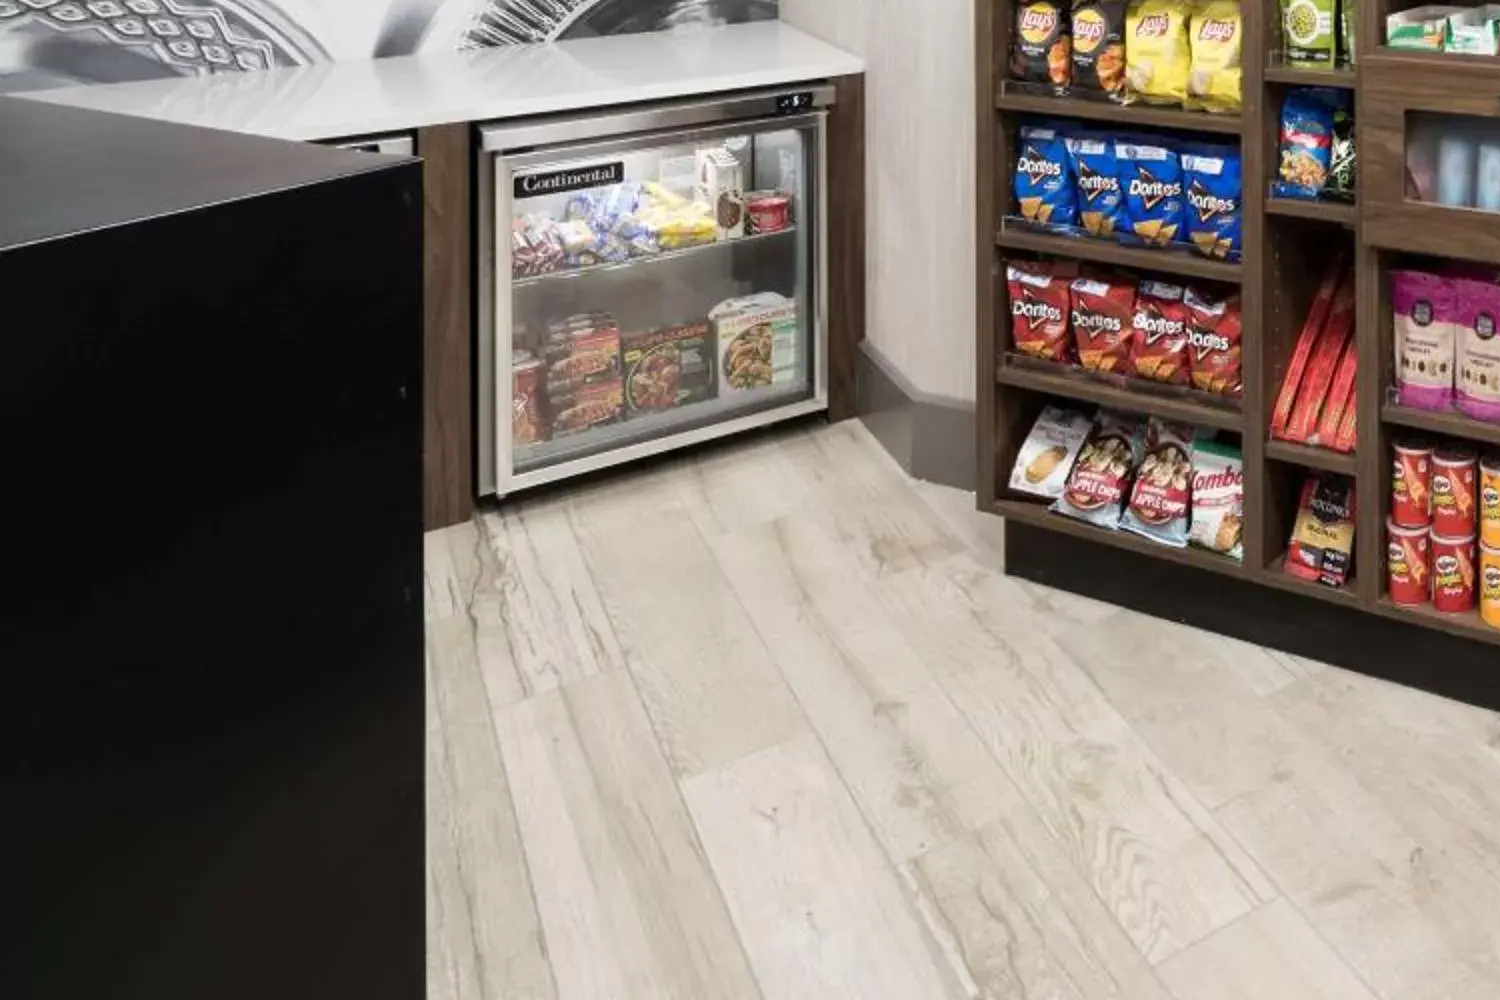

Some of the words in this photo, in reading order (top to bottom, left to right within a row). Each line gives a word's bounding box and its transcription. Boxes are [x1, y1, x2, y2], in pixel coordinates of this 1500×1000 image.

[1017, 157, 1061, 177] Doritos
[521, 165, 617, 194] Continental
[1129, 177, 1181, 198] Doritos
[1011, 300, 1062, 322] Doritos
[1071, 311, 1122, 333] Doritos
